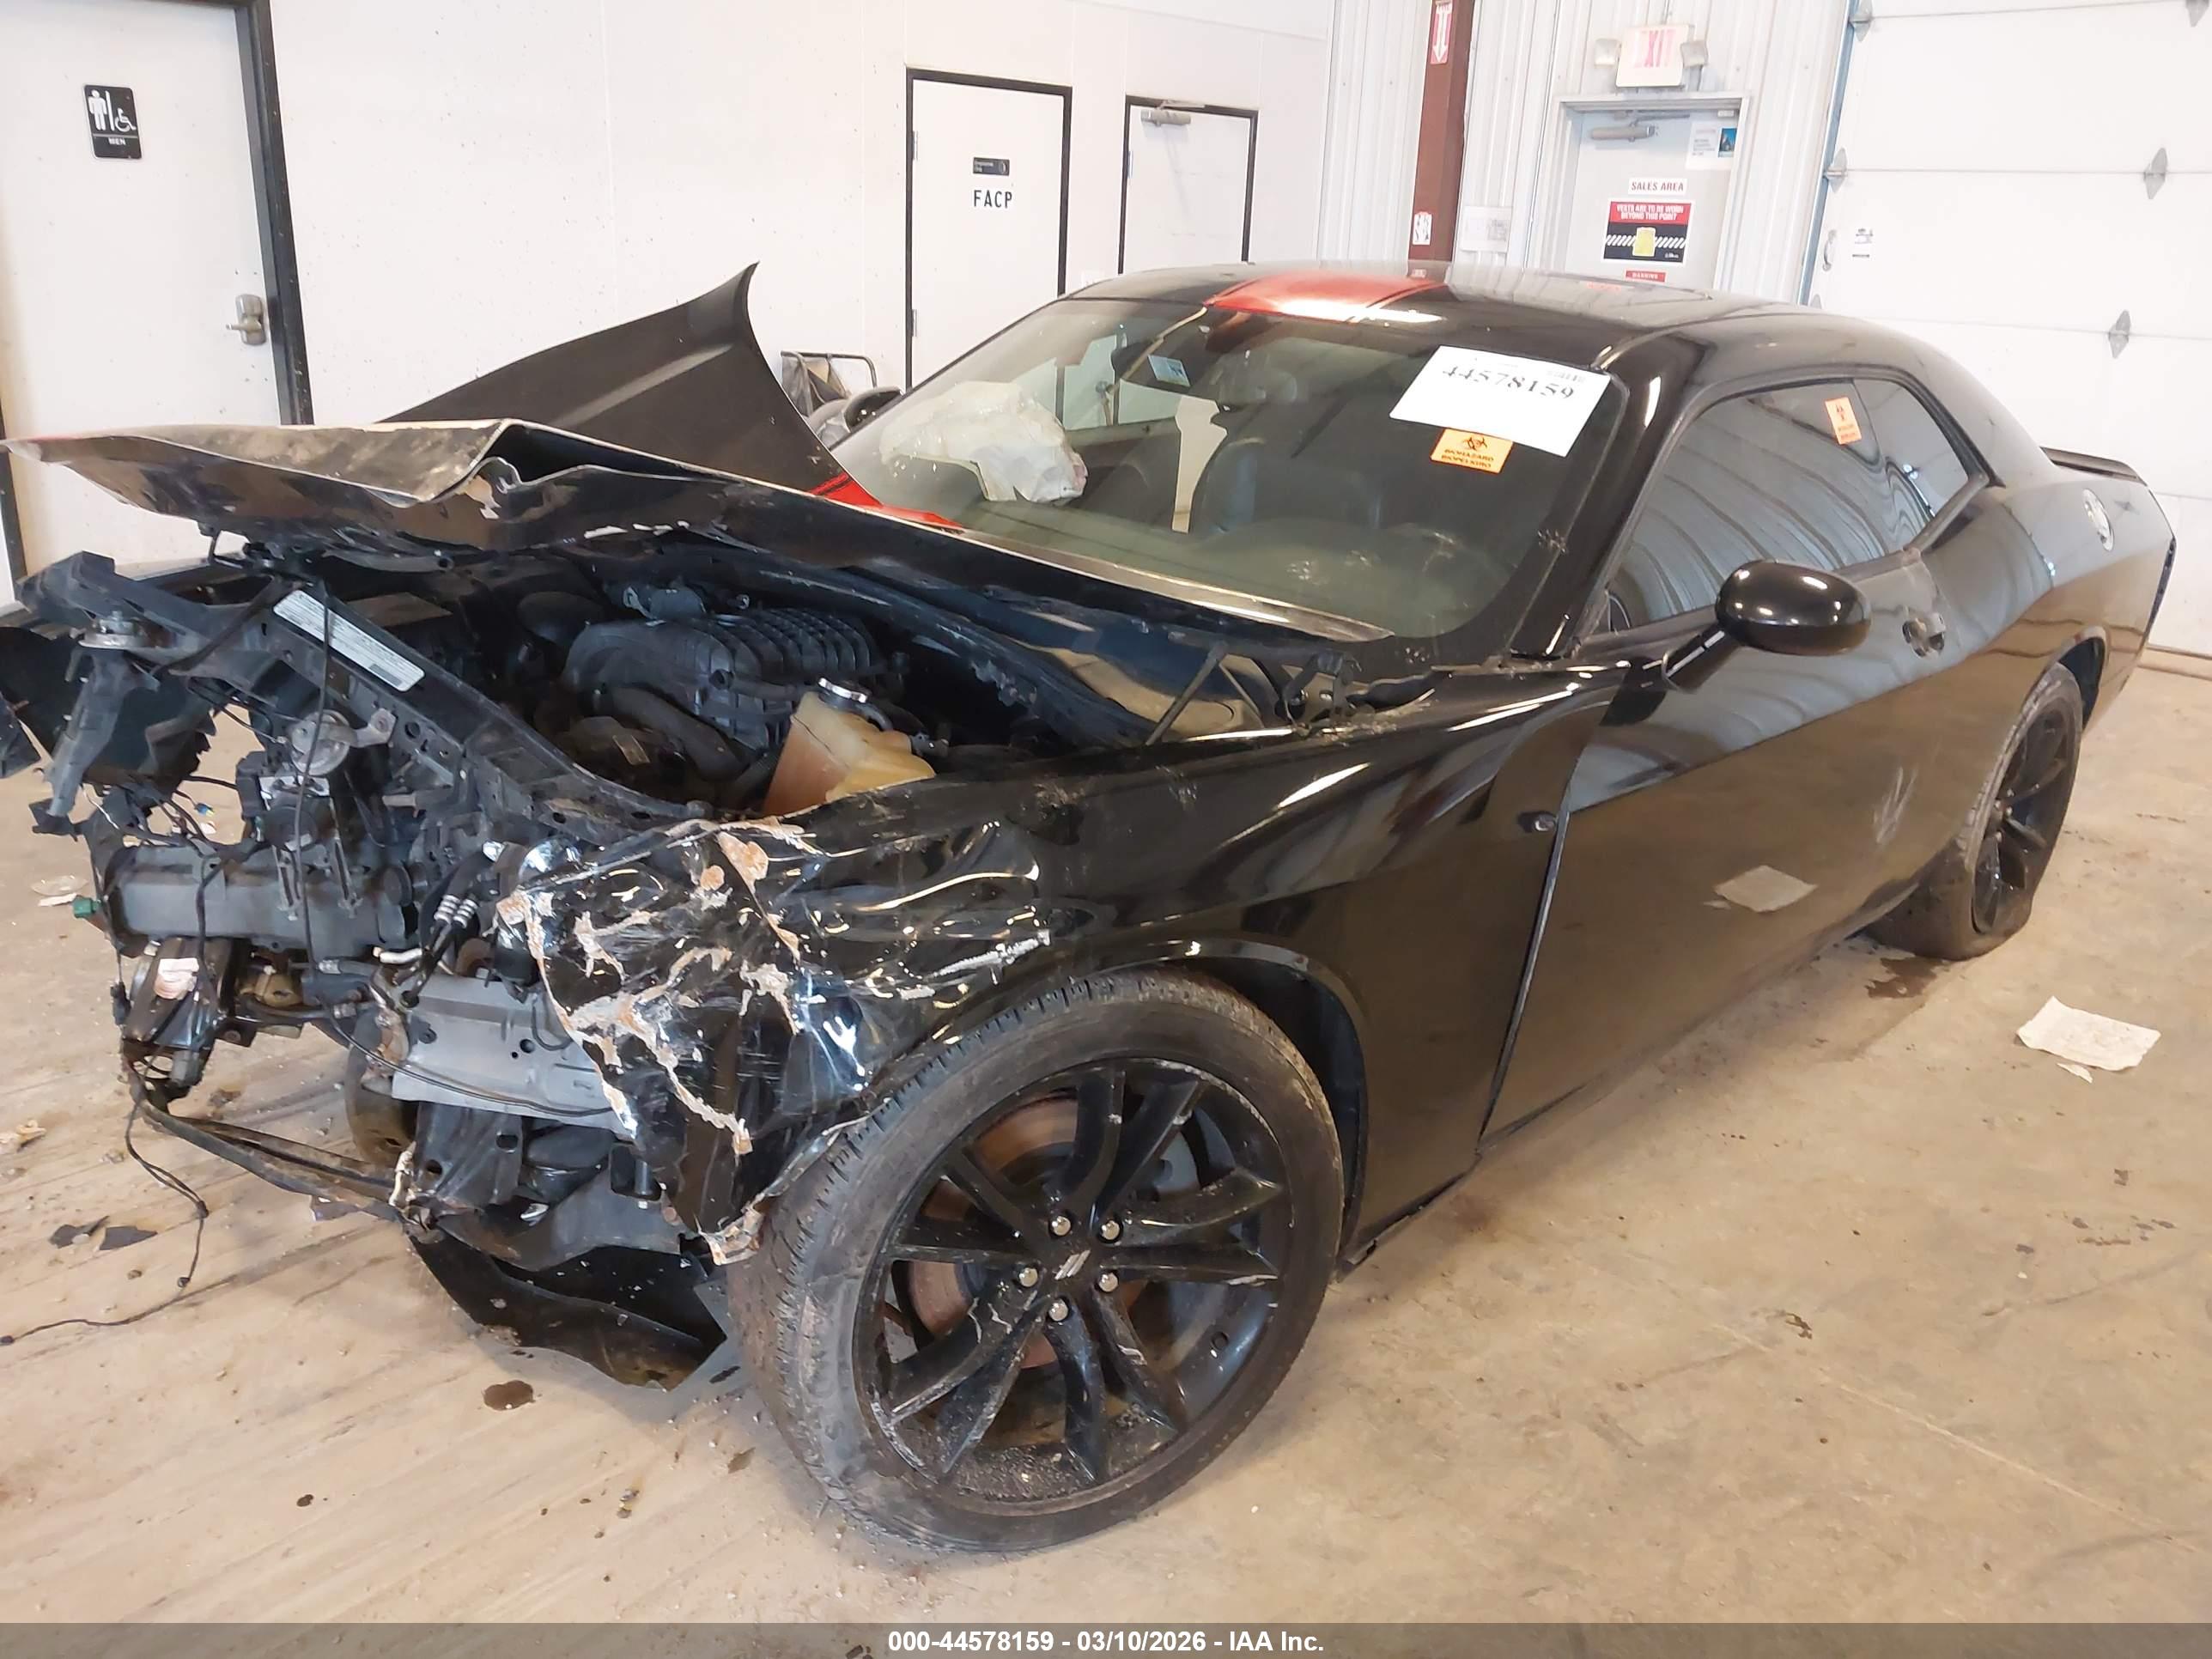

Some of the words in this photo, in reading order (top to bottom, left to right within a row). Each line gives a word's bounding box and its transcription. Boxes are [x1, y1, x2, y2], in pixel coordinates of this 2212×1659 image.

[108, 137, 126, 145] MEN
[1631, 181, 1658, 191] SALES
[1661, 181, 1684, 191] AREA
[974, 190, 1012, 208] FACP
[1443, 365, 1575, 399] 44578159
